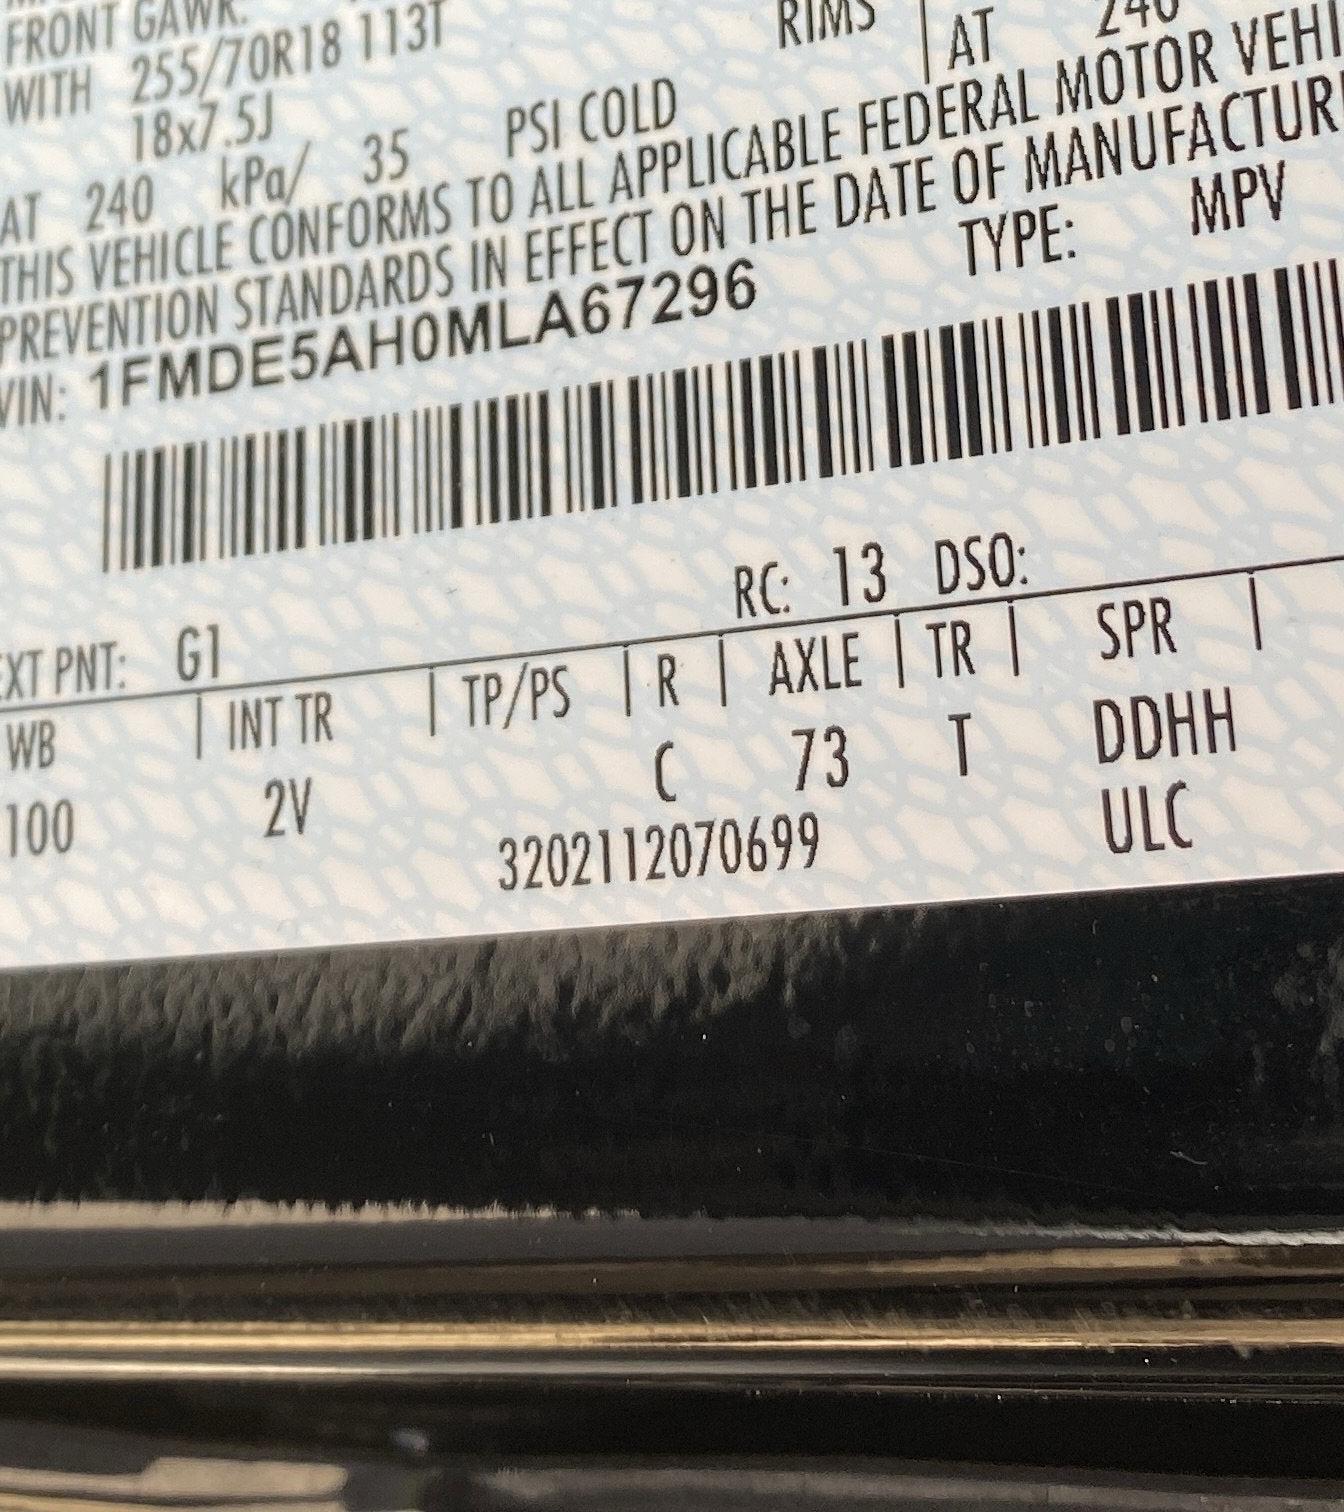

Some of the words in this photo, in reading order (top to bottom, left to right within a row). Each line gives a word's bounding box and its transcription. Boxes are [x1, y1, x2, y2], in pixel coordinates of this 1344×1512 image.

[6, 3, 115, 67] FRONT
[947, 7, 994, 70] AT
[5, 65, 92, 124] WITH
[132, 20, 341, 103] 255/70R18
[0, 192, 42, 245] AT
[86, 175, 154, 233] 240
[221, 142, 311, 209] kPa/
[363, 129, 410, 184] 35
[506, 98, 559, 158] PSI
[580, 77, 676, 143] COLD
[0, 246, 73, 304] THIS
[90, 220, 233, 288] VEHICLE
[249, 184, 452, 265] CONFORMS
[467, 173, 513, 228] TO
[530, 161, 593, 219] ALL
[610, 108, 842, 205] APPLICABLE
[859, 69, 1040, 155] FEDERAL
[1057, 29, 1218, 115] MOTOR
[235, 246, 454, 330] STANDARDS
[471, 234, 506, 292] IN
[526, 209, 653, 283] EFFECT
[672, 198, 726, 256] ON
[741, 180, 816, 245] THE
[835, 157, 936, 229] DATE
[952, 142, 1006, 206] OF
[959, 202, 1078, 276] TYPE:
[1190, 161, 1286, 236] MPV
[90, 258, 756, 410] 1FMDE5AH0MLA67296
[736, 560, 790, 618] RC:
[834, 542, 887, 606] 13
[937, 532, 1028, 594] DSO:
[56, 641, 127, 696] PNT:
[176, 625, 220, 682] G1
[926, 620, 976, 678] TR
[1097, 597, 1177, 661] SPR
[462, 662, 571, 730] TP/PS
[659, 652, 679, 707] R
[769, 632, 862, 696] AXLE
[6, 720, 56, 770] WB
[228, 695, 279, 751] INT
[295, 691, 334, 745] TR
[948, 712, 972, 777] T
[1094, 687, 1237, 763] DDHH
[656, 741, 677, 802] C
[792, 725, 848, 791] 73
[5, 799, 74, 858] 100
[264, 778, 312, 838] 2V
[1101, 781, 1194, 853] ULC
[497, 811, 820, 891] 3202112070699
